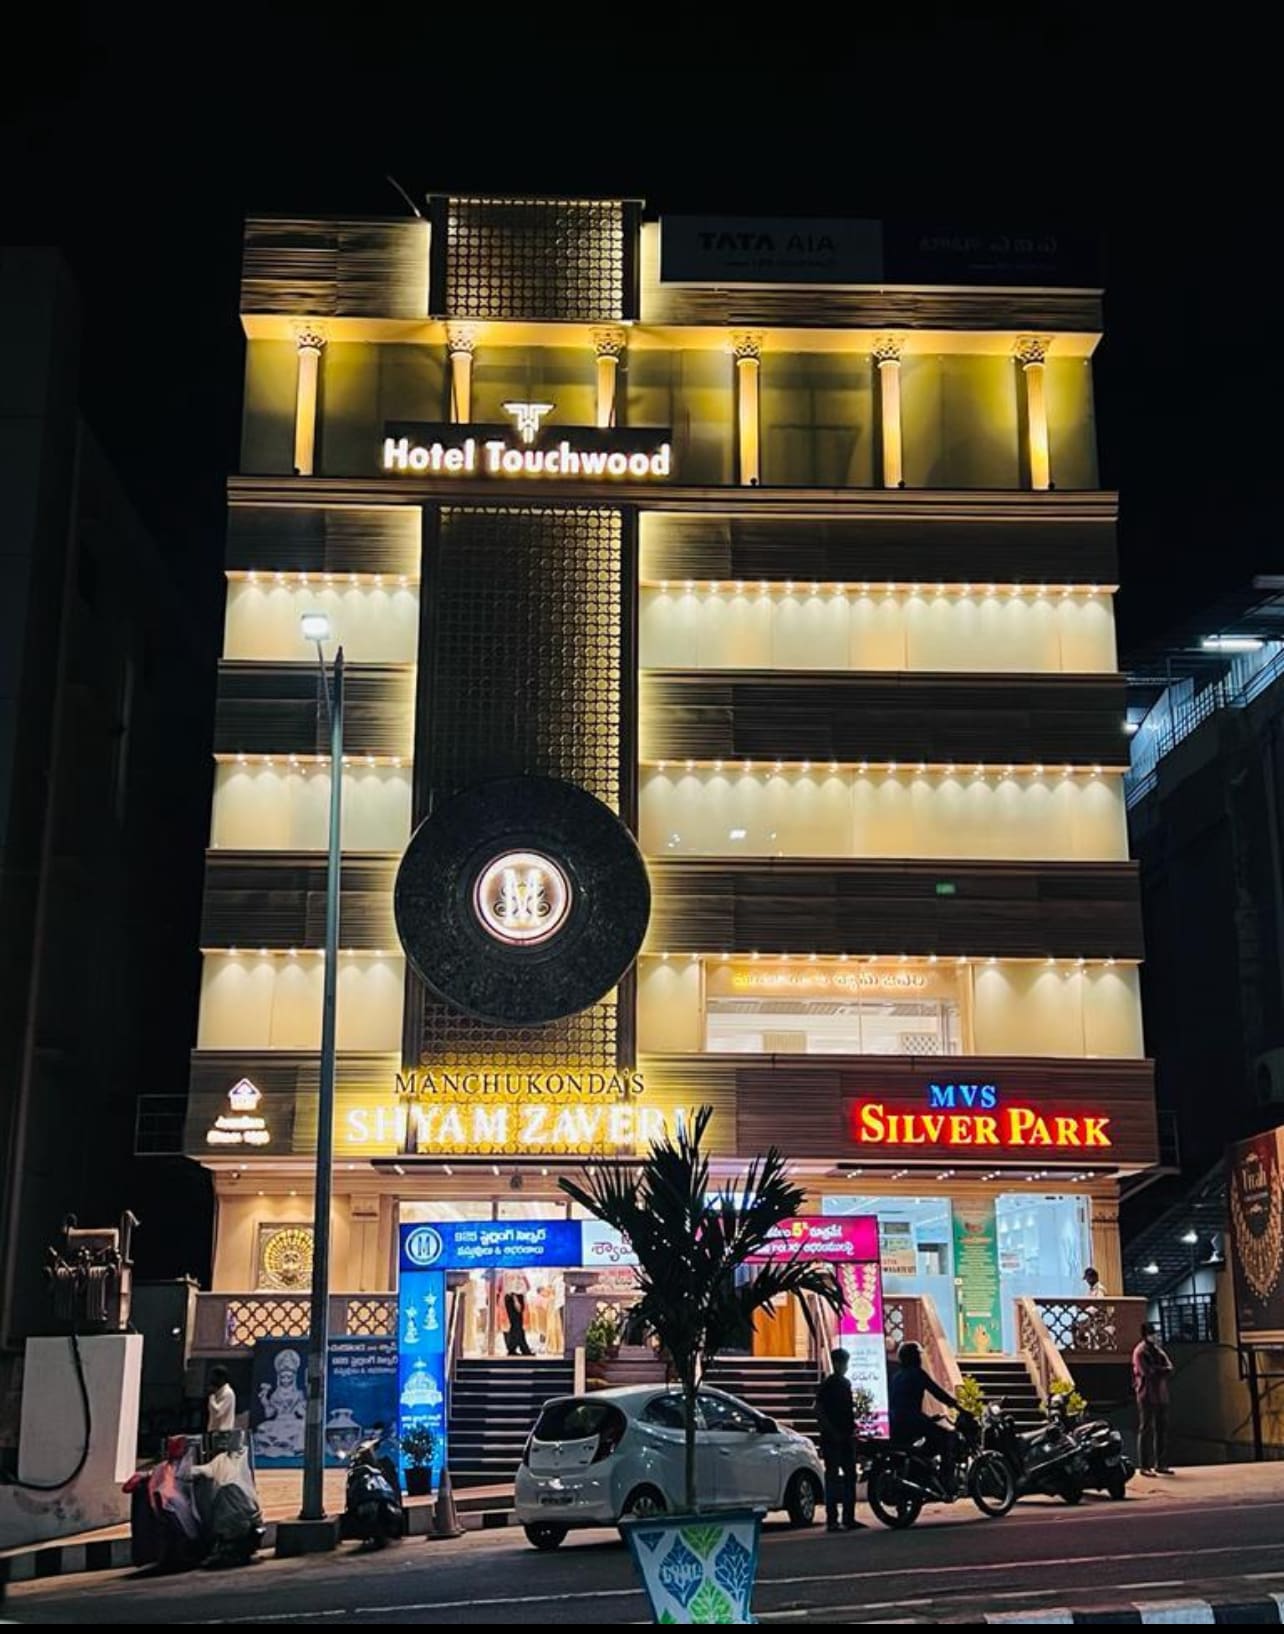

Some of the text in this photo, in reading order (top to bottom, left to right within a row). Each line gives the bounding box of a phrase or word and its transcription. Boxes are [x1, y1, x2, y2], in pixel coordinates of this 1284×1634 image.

[698, 232, 836, 252] TATA AIA
[383, 437, 671, 476] Hotel Touchwood
[929, 1084, 997, 1109] MVS
[346, 1105, 507, 1143] SHYAM
[860, 1103, 1112, 1147] SILVER PARK
